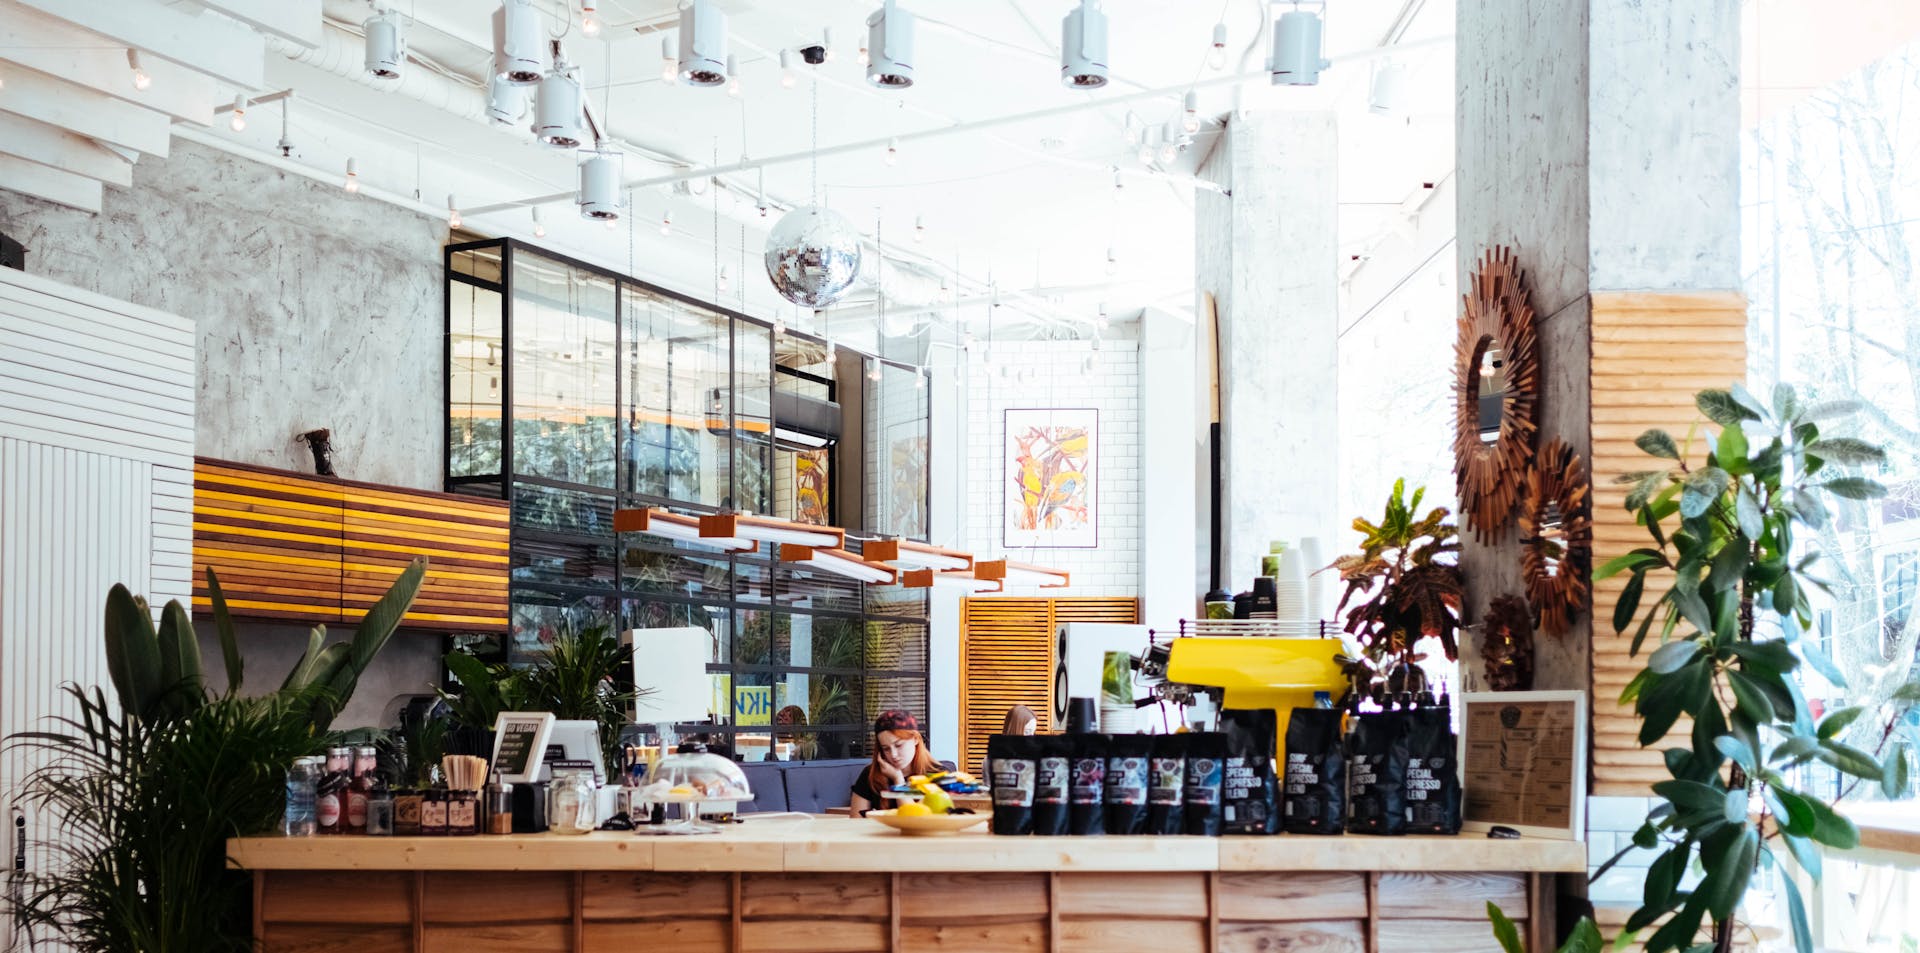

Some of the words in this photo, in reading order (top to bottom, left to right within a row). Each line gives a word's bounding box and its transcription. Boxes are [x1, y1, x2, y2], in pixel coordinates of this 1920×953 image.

[515, 723, 538, 732] VEGAN
[1225, 767, 1254, 777] SPECIAL
[1406, 768, 1434, 779] PECIAL
[1406, 779, 1441, 790] SPRESSO
[1406, 789, 1428, 800] LEND
